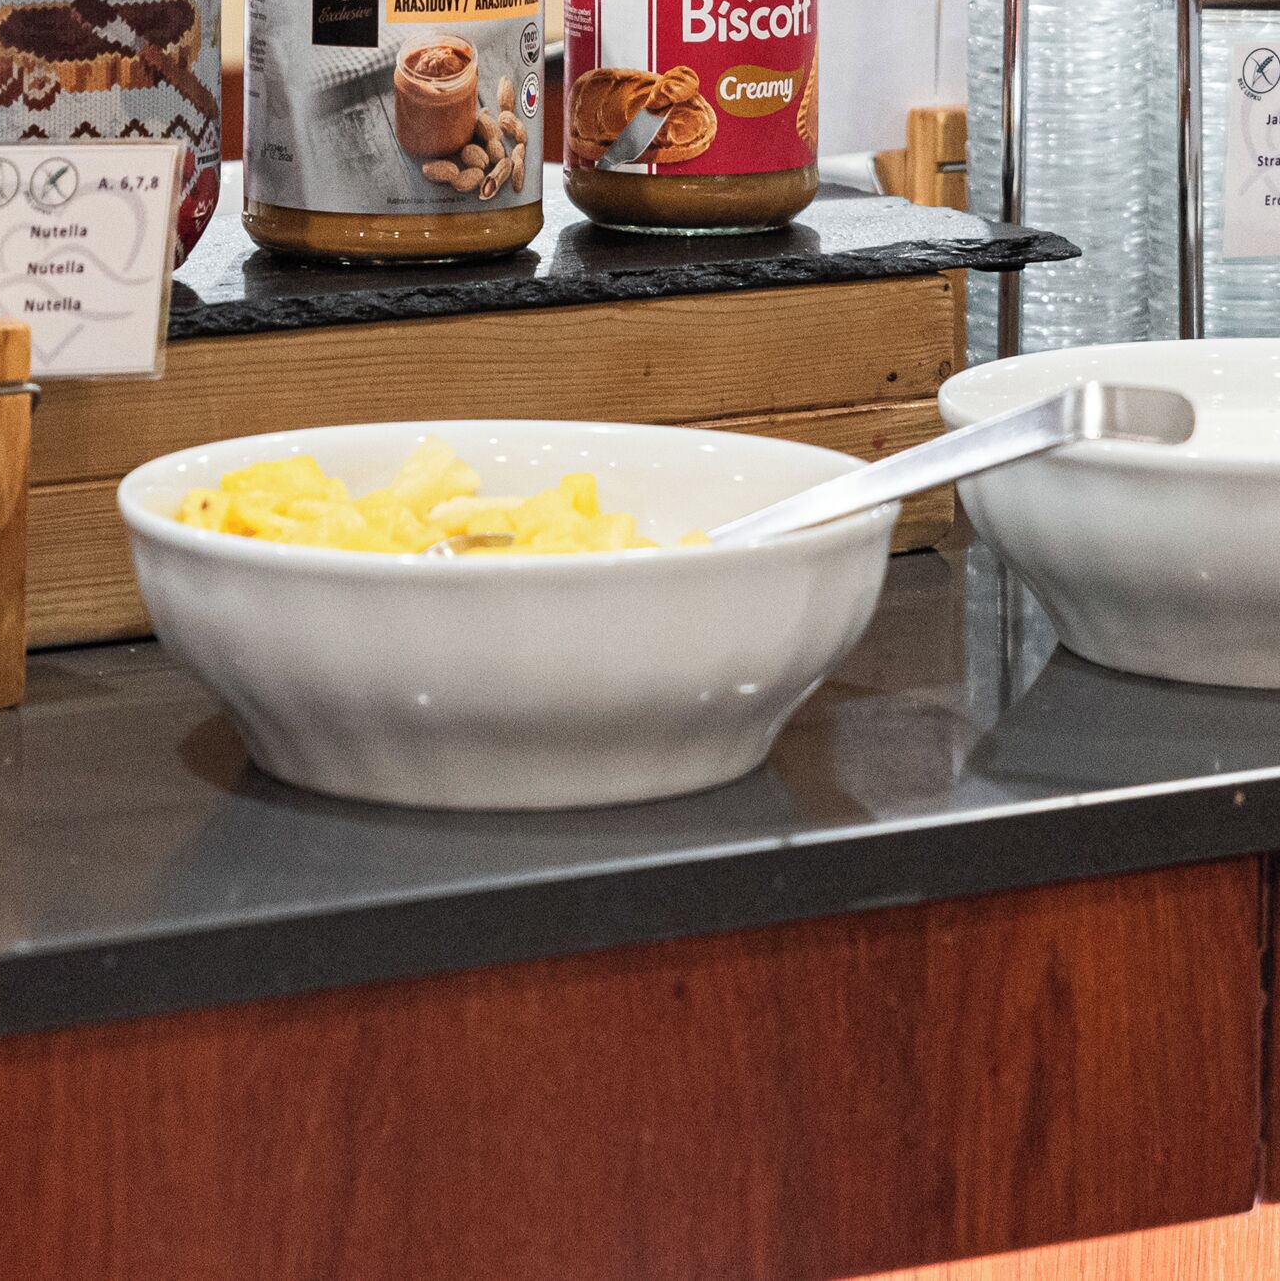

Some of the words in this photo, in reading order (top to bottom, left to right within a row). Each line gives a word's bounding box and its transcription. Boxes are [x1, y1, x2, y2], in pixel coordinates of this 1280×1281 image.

[719, 75, 793, 103] Creamy
[97, 176, 114, 192] A.
[29, 224, 88, 240] Nutella
[27, 260, 85, 276] Nutella
[24, 297, 82, 314] Nutella
